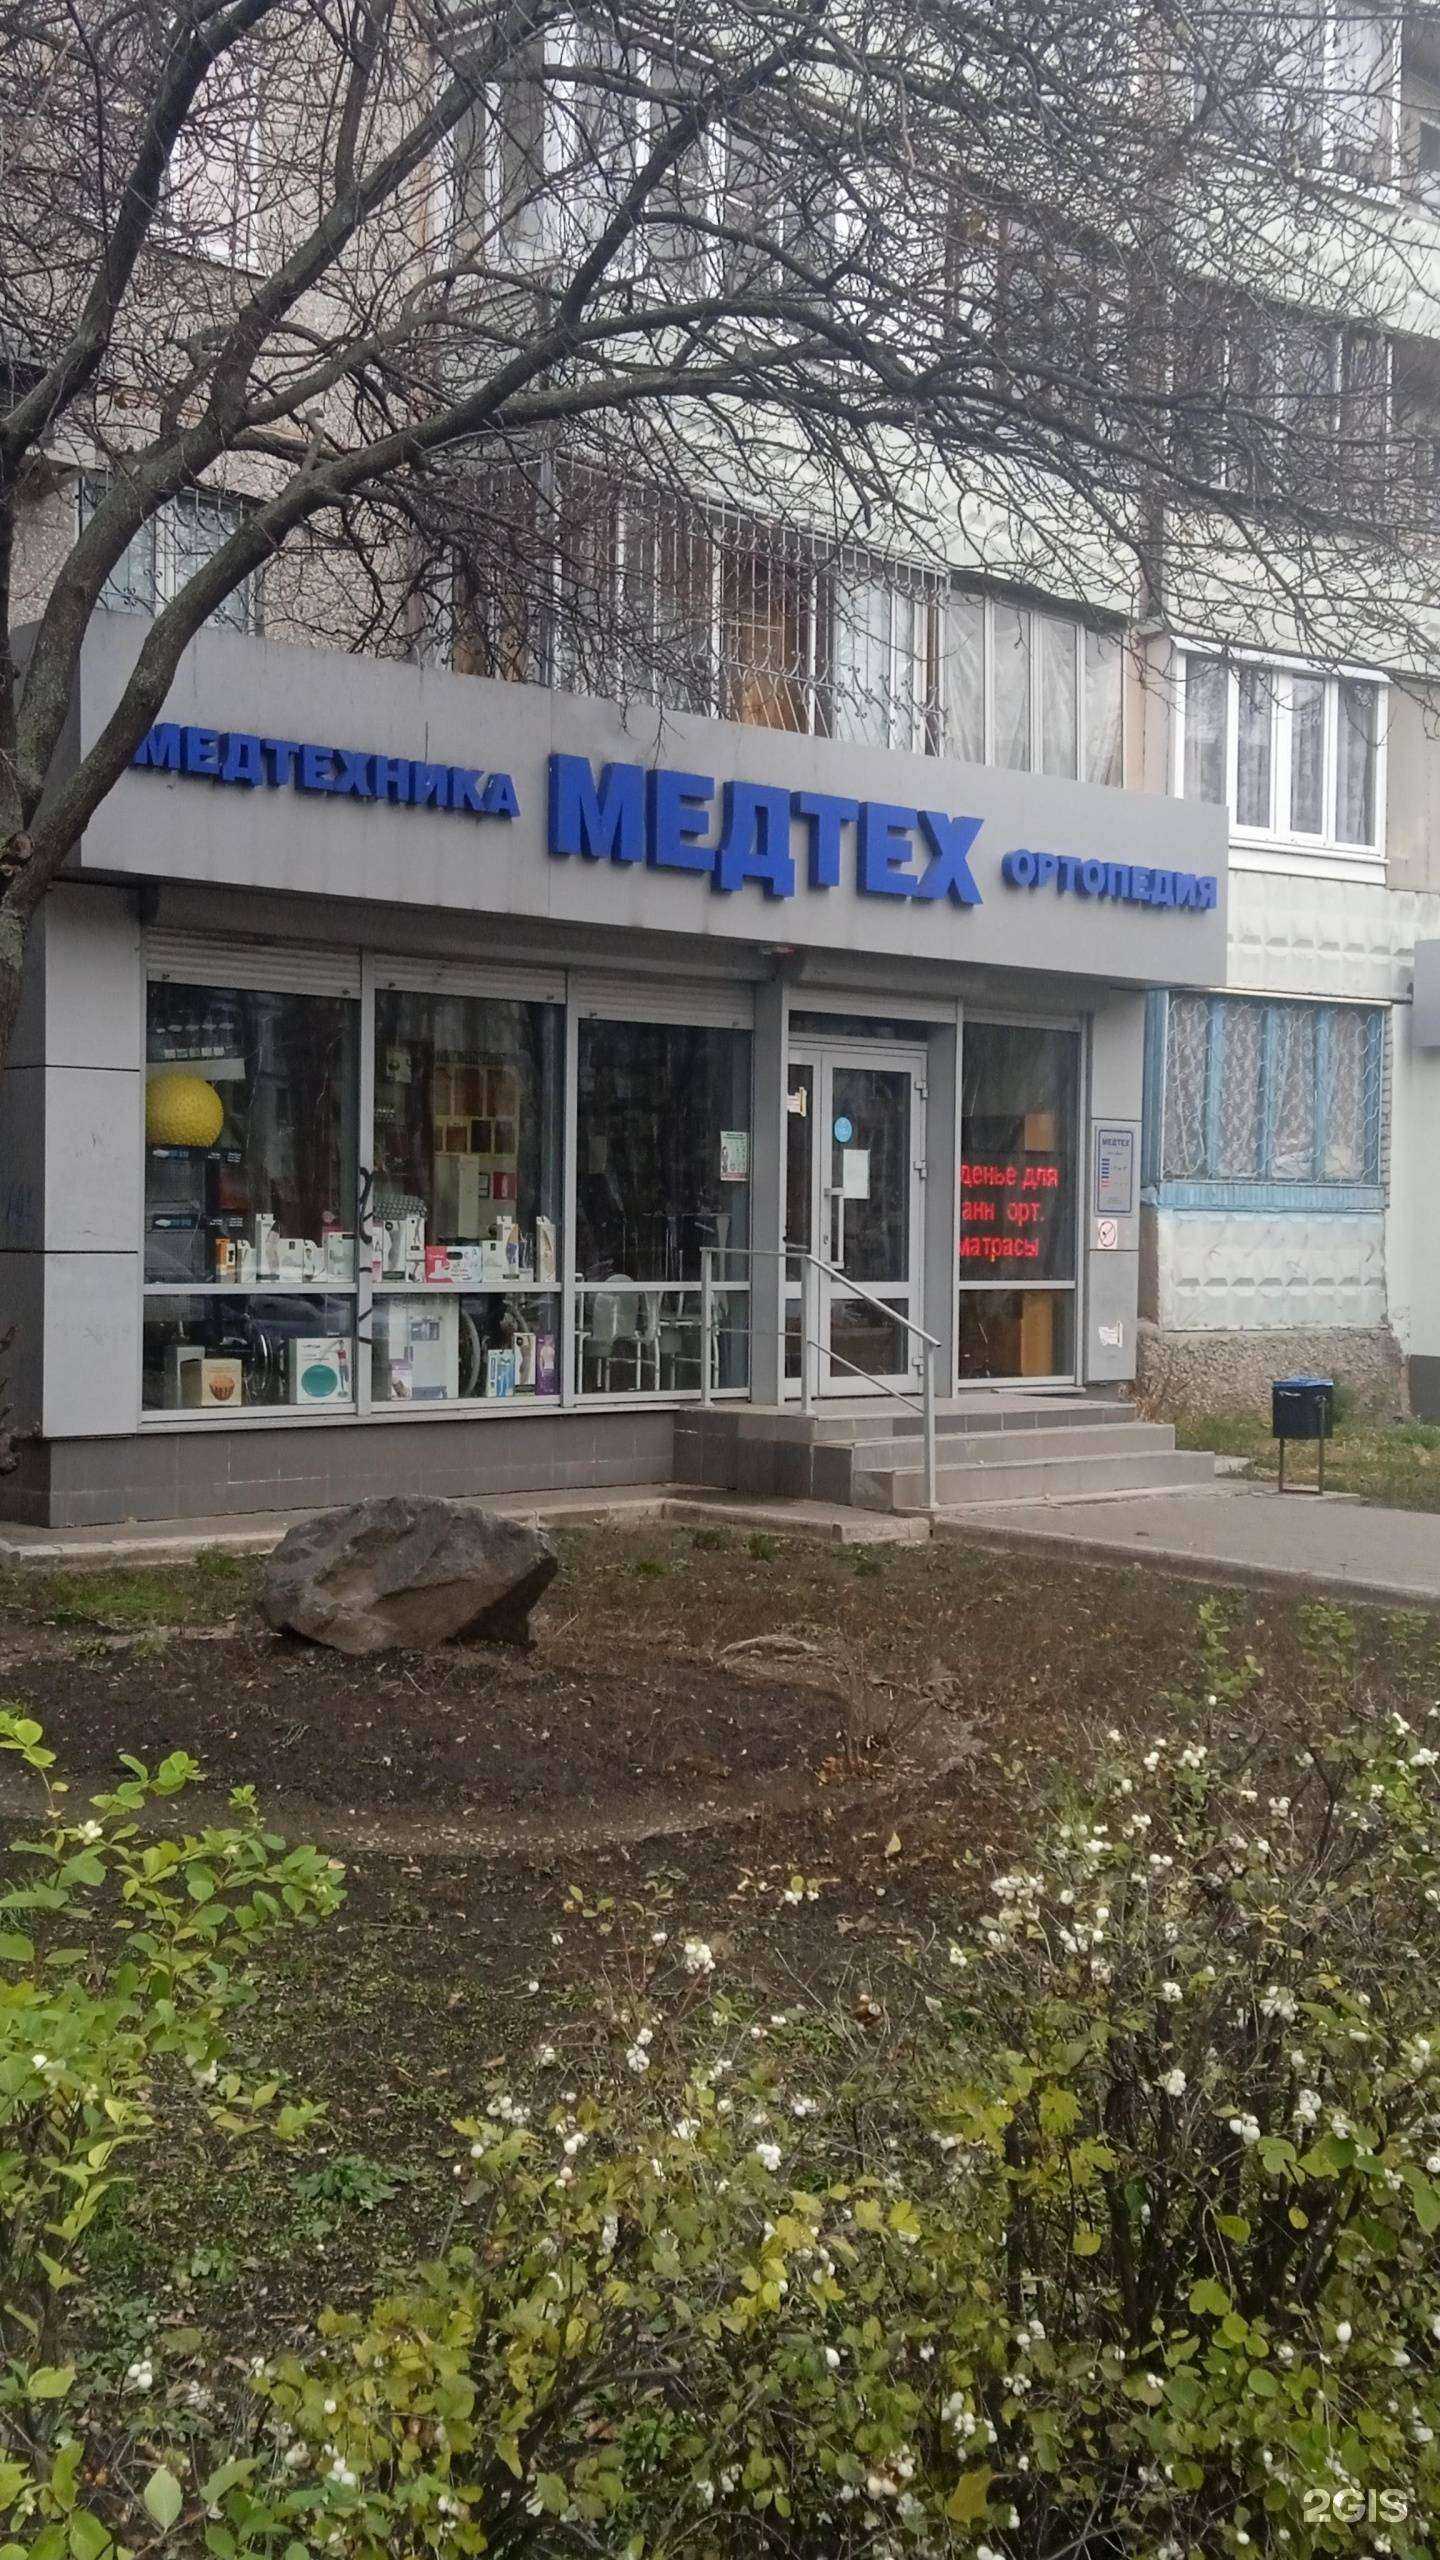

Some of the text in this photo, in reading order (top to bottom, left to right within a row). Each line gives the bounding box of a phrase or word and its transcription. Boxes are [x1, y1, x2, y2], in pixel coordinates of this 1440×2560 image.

[134, 722, 521, 817] МЕДТЕХНИКА
[549, 753, 985, 906] МЕДТЕХ
[1002, 849, 1218, 909] ОРТОПЕДИЯ
[1022, 1166, 1059, 1190] для
[1007, 1202, 1045, 1227] орт.
